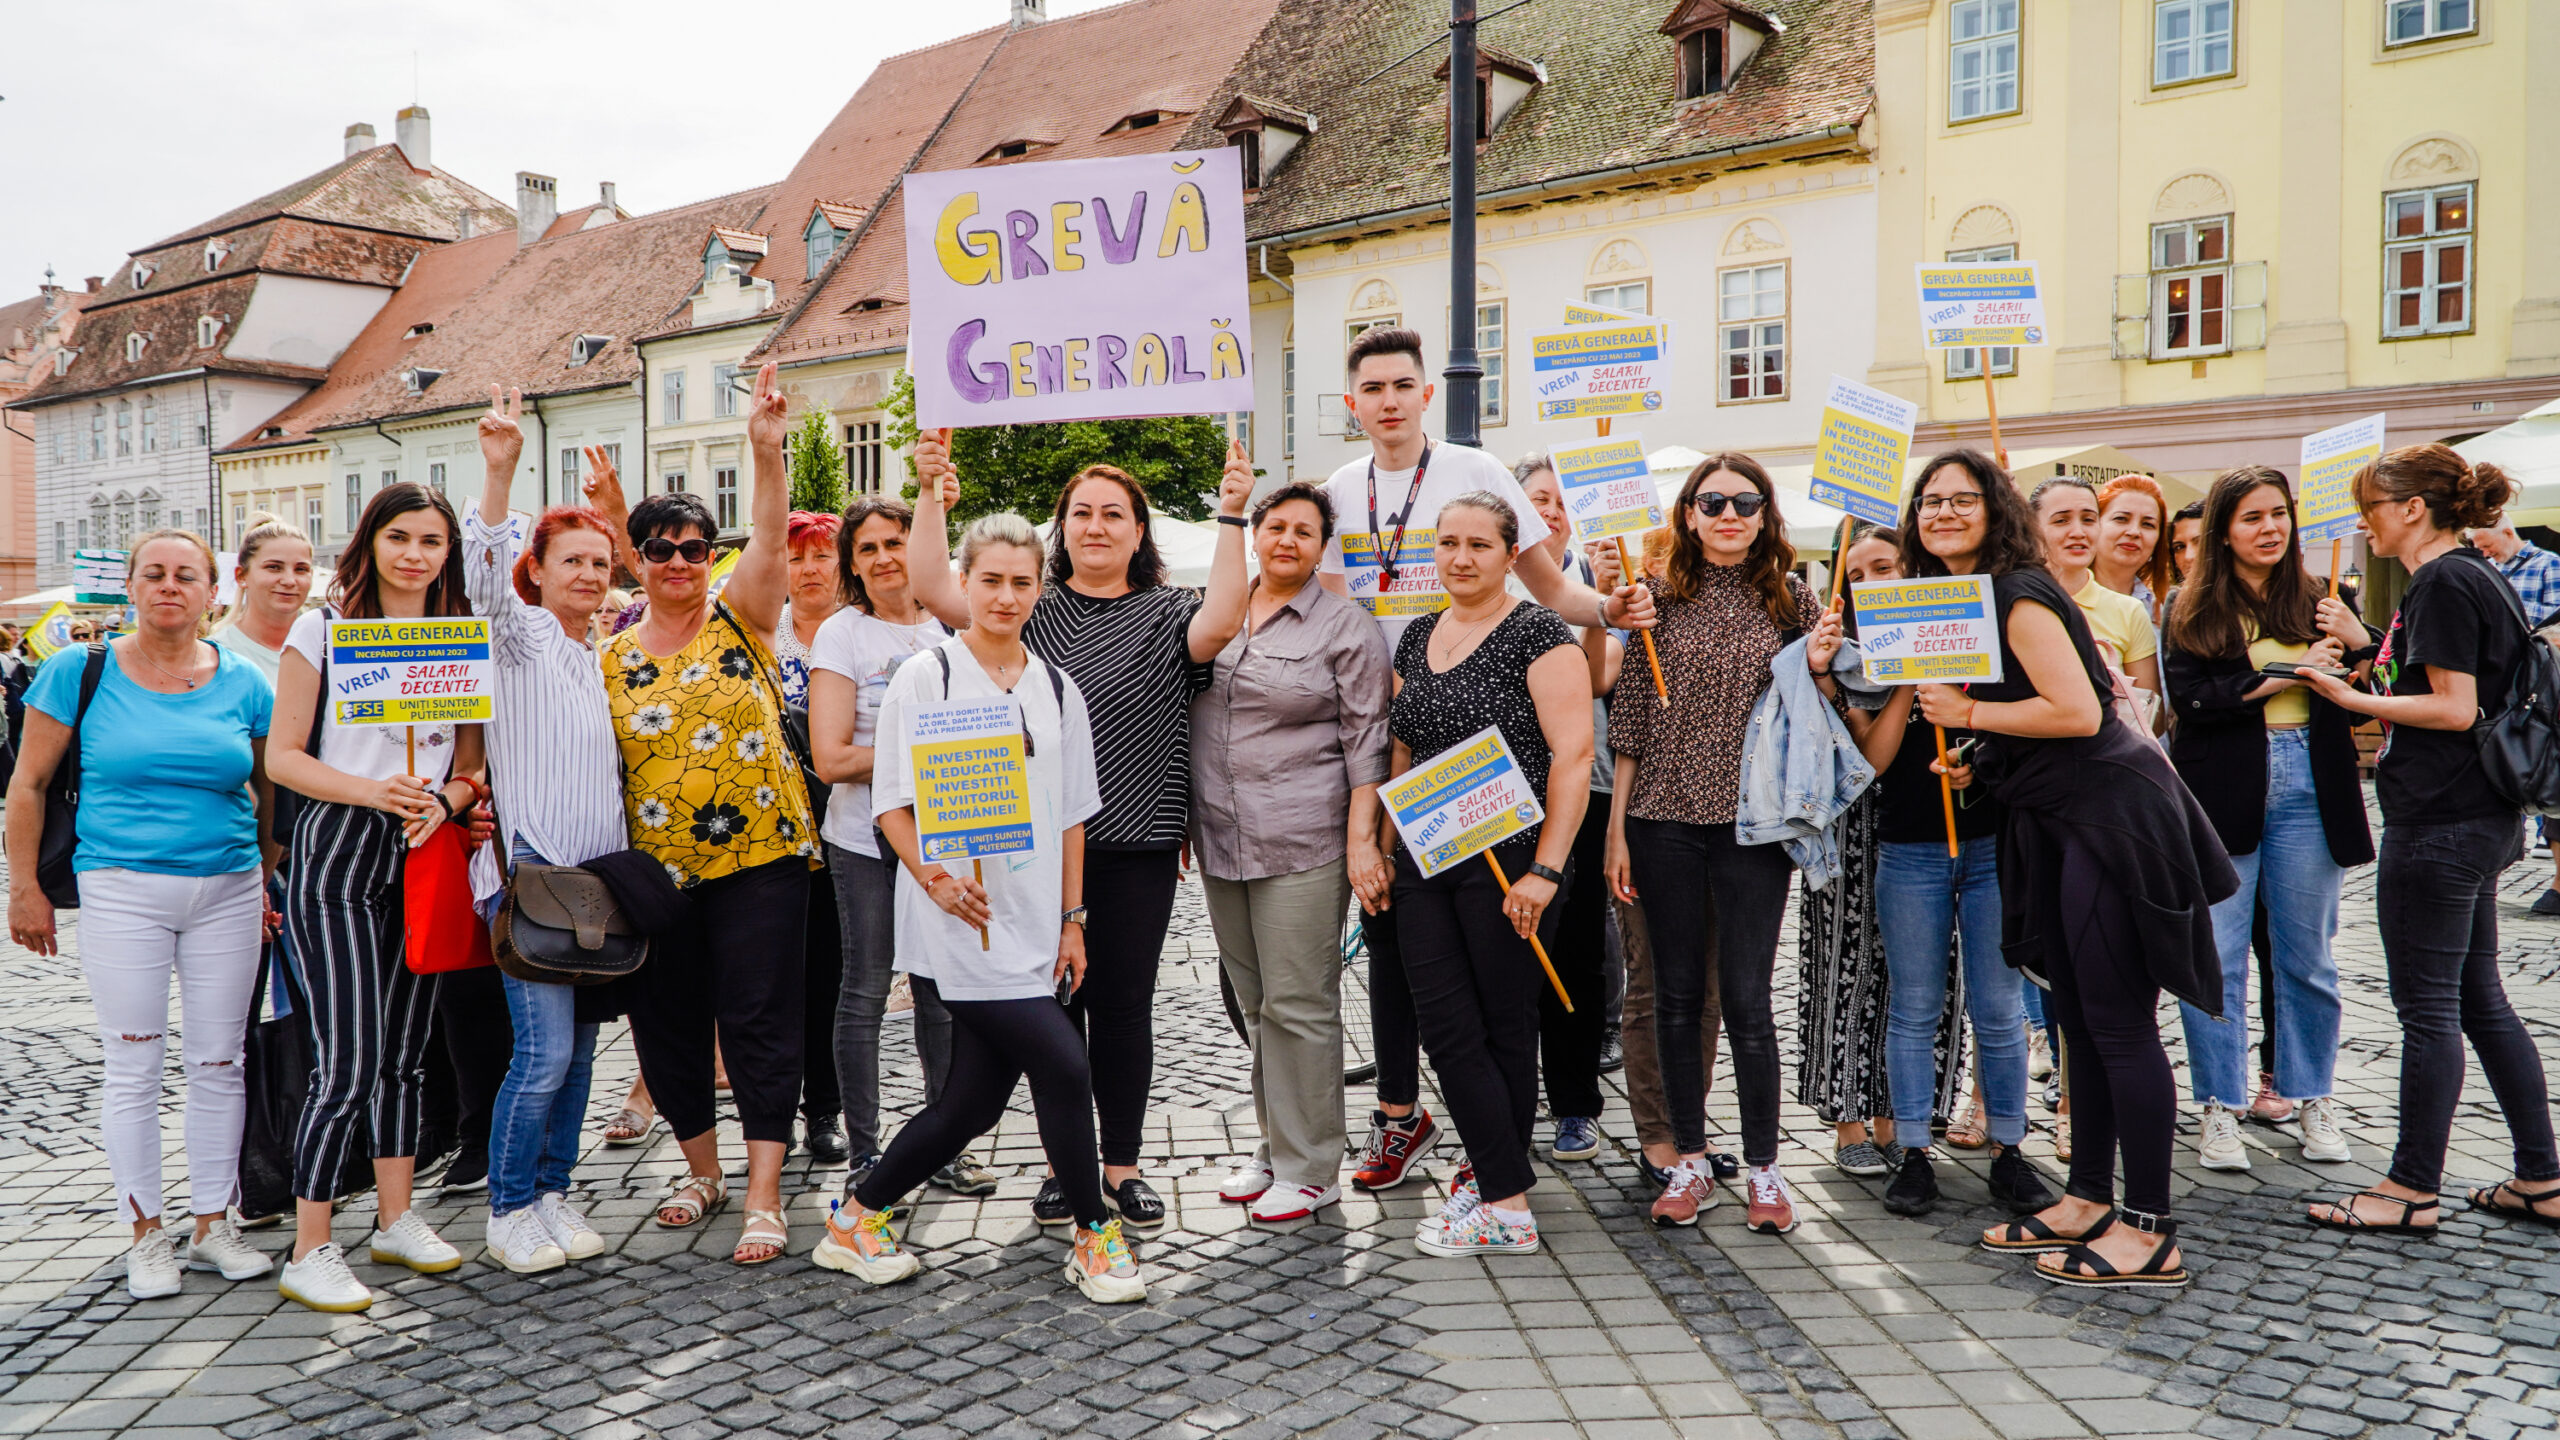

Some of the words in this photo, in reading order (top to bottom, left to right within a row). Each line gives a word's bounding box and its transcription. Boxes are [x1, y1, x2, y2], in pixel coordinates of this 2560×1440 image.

[935, 158, 1210, 286] GREVĂ
[1924, 272, 1965, 284] GREVĂ
[1968, 271, 2032, 284] GENERALĂ
[1928, 304, 1966, 324] VREM
[1977, 302, 2022, 312] SALARII
[1973, 314, 2031, 325] DECENTE!
[1536, 336, 1581, 353] GREVĂ
[1584, 330, 1654, 348] GENERALĂ
[1942, 330, 1963, 340] FSE
[946, 318, 1245, 404] GENERALĂ
[1592, 365, 1643, 379] SALARII
[1538, 371, 1580, 396] VREM
[1588, 377, 1651, 393] DECENTE!
[1552, 401, 1575, 412] FSE
[1600, 396, 1631, 404] SUNTEM
[1825, 427, 1837, 439] ÎN
[1834, 419, 1898, 447] INVESTIND
[1560, 451, 1593, 470] GREVĂ
[1594, 444, 1642, 464] GENERALĂ
[1824, 450, 1836, 463] ÎN
[1841, 457, 1895, 483] VIITORUL
[2310, 454, 2369, 478] INVESTIND
[1608, 480, 1640, 495] SALARII
[1824, 487, 1846, 502] FSE
[1571, 488, 1600, 514] VREM
[1607, 491, 1648, 510] DECENTE!
[2307, 526, 2327, 538] FSE
[1344, 537, 1372, 549] GREV
[1394, 566, 1435, 578] ALARII
[1348, 569, 1378, 592] VREM
[1408, 596, 1444, 604] SUNTEM
[1858, 588, 1903, 606] GREVĂ
[1906, 582, 1979, 602] GENERALĂ
[336, 625, 393, 642] GREVĂ
[398, 623, 484, 640] GENERALĂ
[1917, 623, 1969, 638] SALARII
[1864, 627, 1905, 654] VREM
[1913, 637, 1978, 653] DECENTE!
[355, 649, 400, 658] ÎNCEPÂND
[428, 649, 445, 657] MAI
[1942, 656, 1981, 665] SUNTEM
[406, 664, 469, 678] SALARII
[1878, 660, 1903, 672] FSE
[1925, 666, 1976, 676] PUTERNICI!
[337, 666, 390, 694] VREM
[400, 679, 479, 695] DECENTE!
[353, 702, 383, 715] FSE
[433, 698, 479, 709] SUNTEM
[411, 709, 472, 720] PUTERNICI!
[956, 708, 980, 716] DORIT
[928, 747, 1010, 765] INVESTIND
[920, 768, 935, 781] ÎN
[941, 760, 1021, 778] EDUCAȚIE,
[1393, 774, 1435, 807] GREVĂ
[1435, 742, 1500, 784] GENERALĂ
[934, 776, 1009, 794] INVESTIȚI
[928, 796, 944, 808] ÎN
[949, 789, 1019, 807] VIITORUL
[1457, 780, 1503, 813] SALARII
[938, 803, 1017, 822] ROMÂNIEI!
[1458, 789, 1516, 828] DECENTE!
[1414, 811, 1449, 848] VREM
[1476, 815, 1506, 834] SUNTEM
[995, 830, 1031, 840] SUNTEM
[1466, 826, 1506, 849] PUTERNICI!
[940, 837, 967, 850] FSE
[978, 840, 1026, 852] PUTERNICI!
[1433, 841, 1458, 861] FSE
